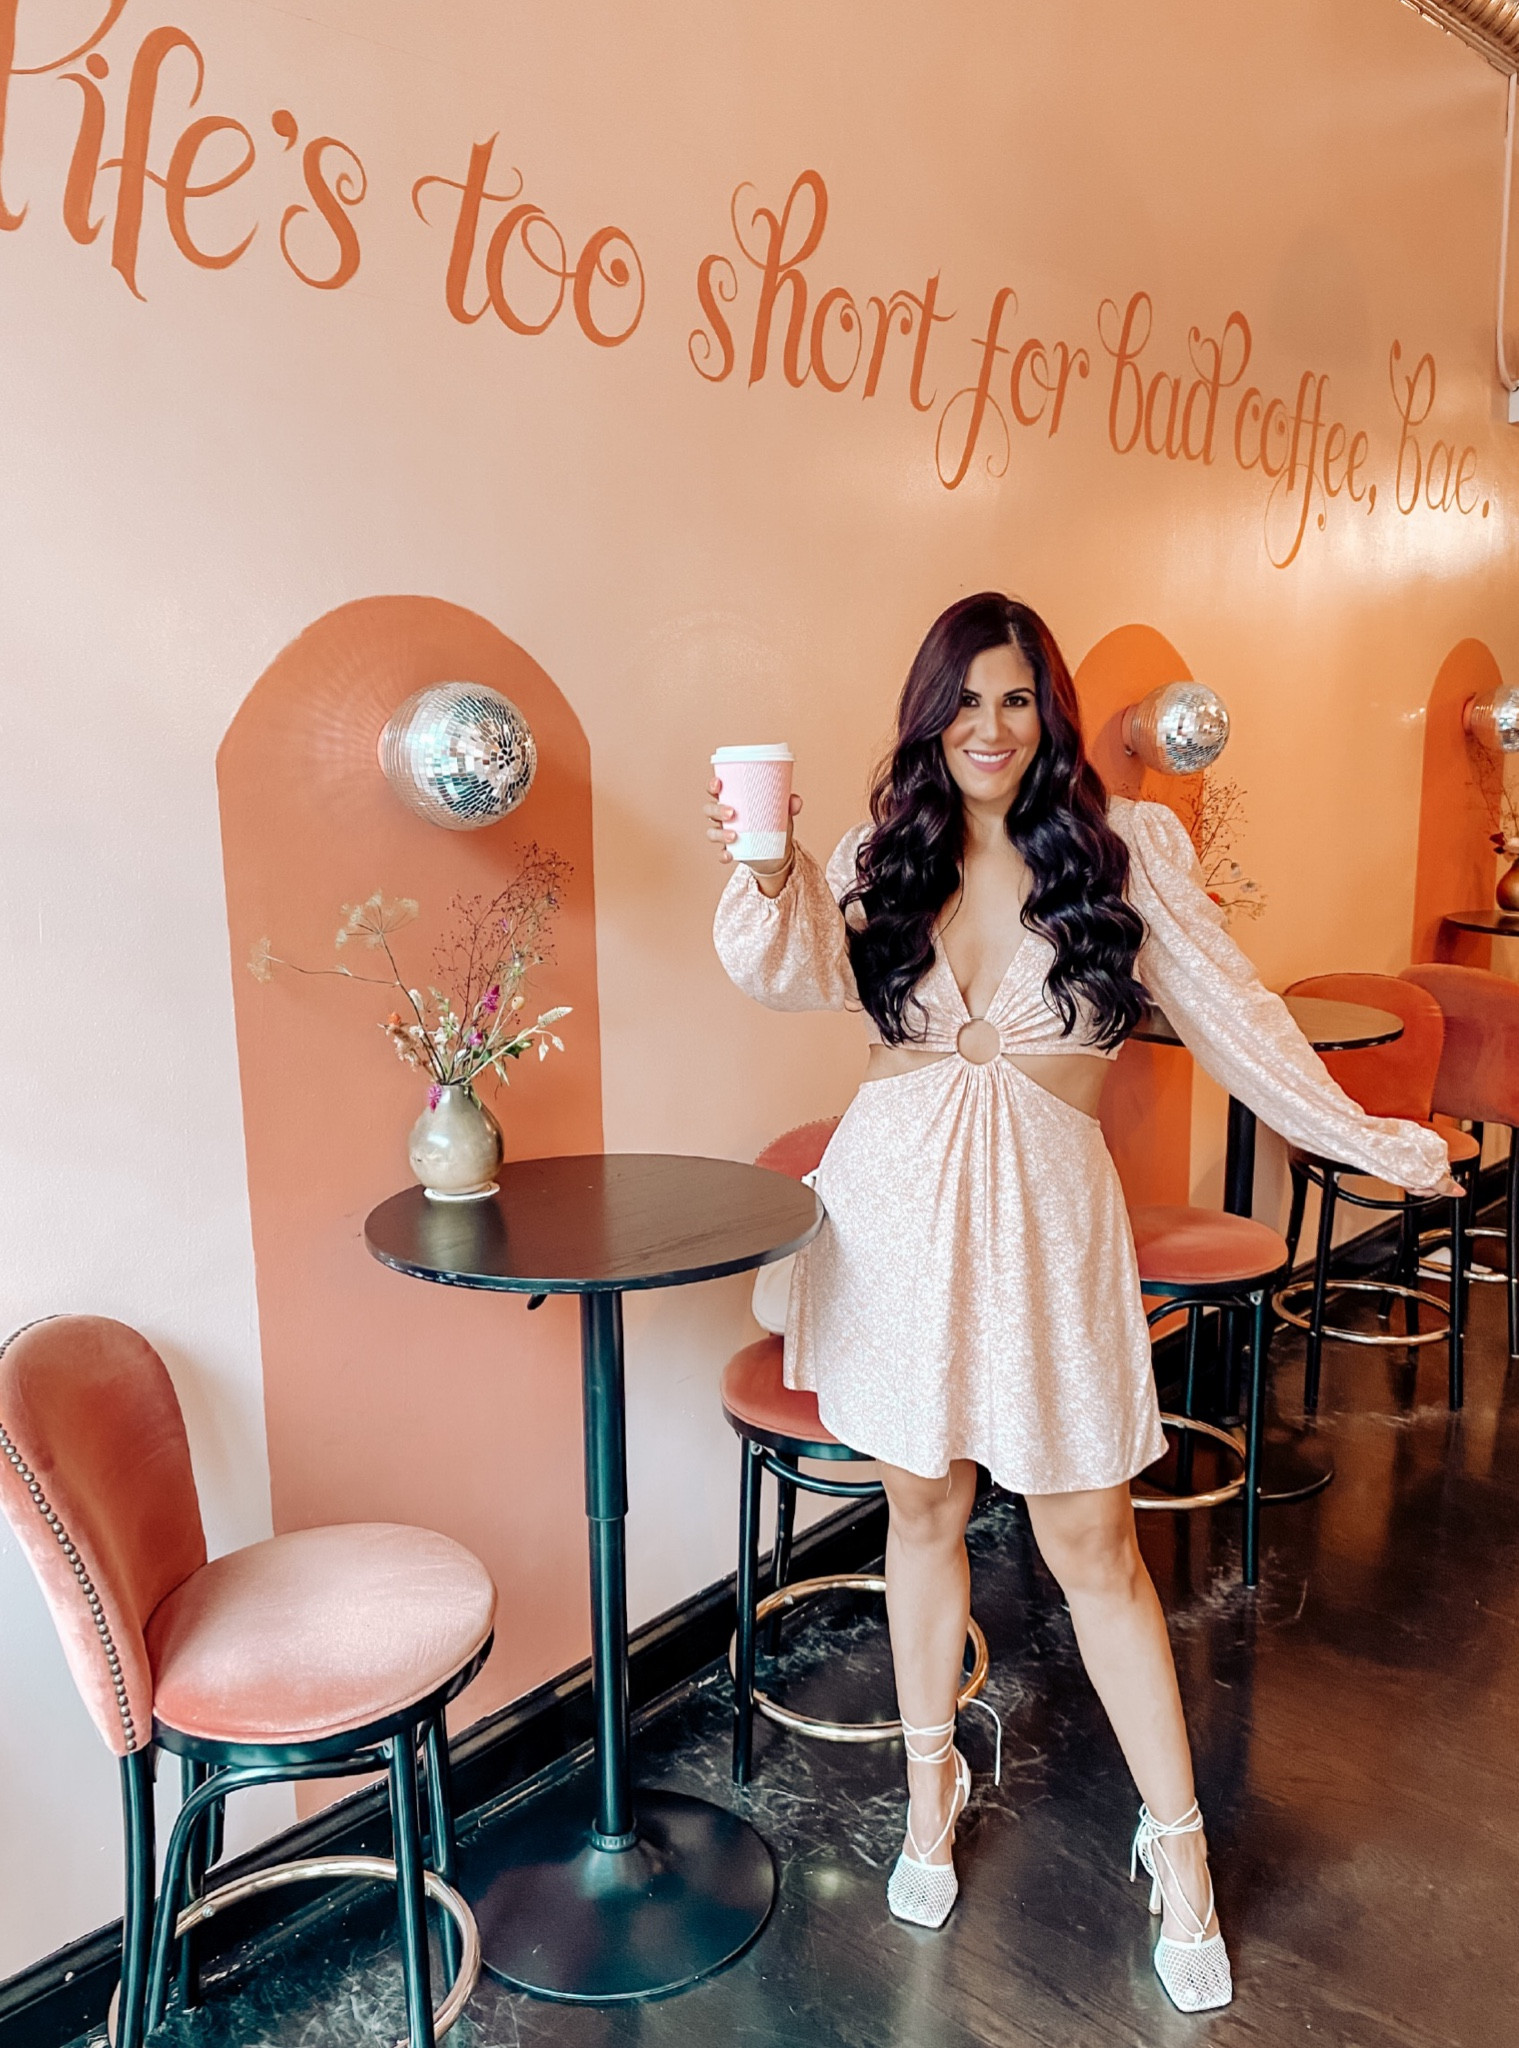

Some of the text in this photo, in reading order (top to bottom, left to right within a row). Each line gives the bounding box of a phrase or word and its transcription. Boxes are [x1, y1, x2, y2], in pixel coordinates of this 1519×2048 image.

[412, 131, 646, 347] too
[688, 167, 958, 413] short
[936, 287, 1089, 490] for
[1097, 291, 1253, 466] bad
[1234, 370, 1377, 569] coffee,
[1389, 338, 1490, 518] bae.
